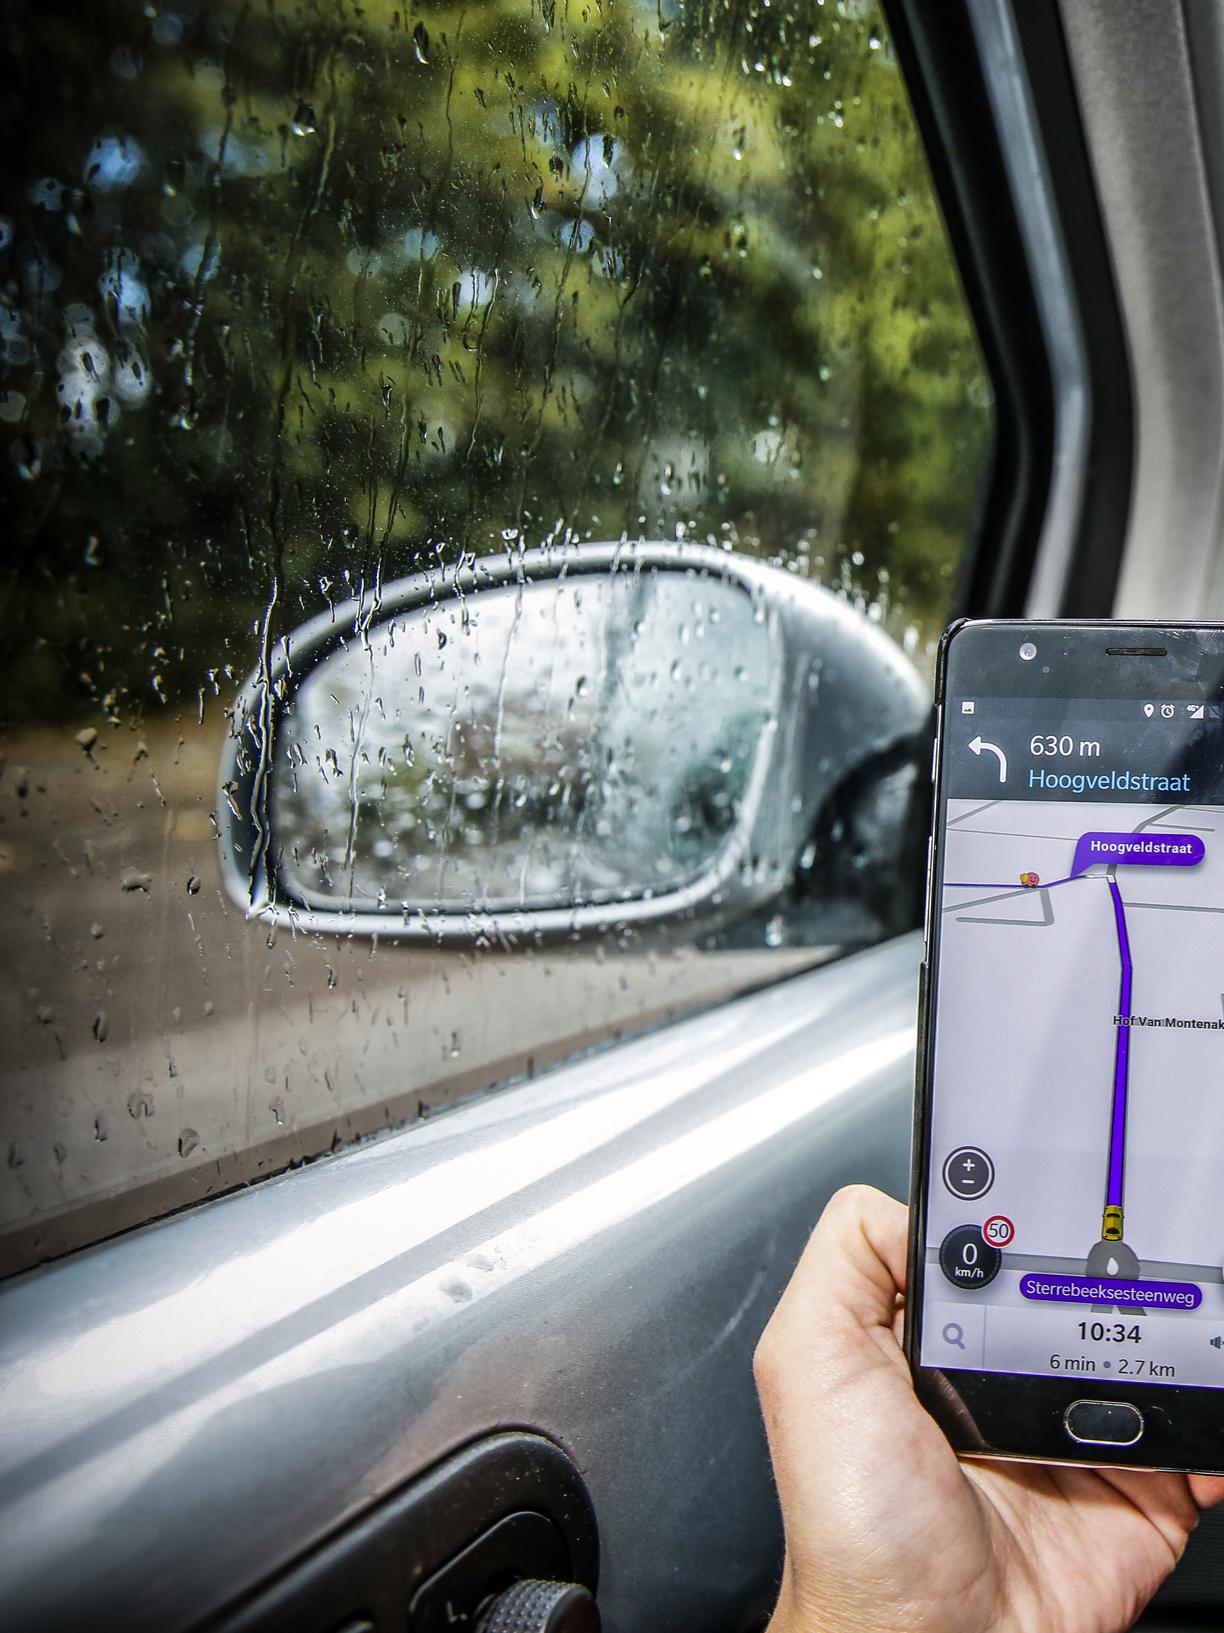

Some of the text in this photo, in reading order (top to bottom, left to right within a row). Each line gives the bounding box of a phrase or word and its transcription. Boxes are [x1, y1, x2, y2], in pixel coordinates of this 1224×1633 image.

[1029, 735, 1101, 757] 630 m
[1028, 769, 1191, 795] Hoogveldstraat
[1090, 839, 1193, 857] Hoogveldstraat
[1113, 1015, 1136, 1027] Hof
[1138, 1016, 1163, 1028] Van
[988, 1222, 1010, 1240] 50
[961, 1243, 978, 1265] 0
[954, 1266, 985, 1280] km/h
[1026, 1279, 1196, 1308] Sterrebeeksesteenweg
[1078, 1321, 1142, 1345] 10:34
[1049, 1353, 1176, 1378] 6 min 2.7 km
